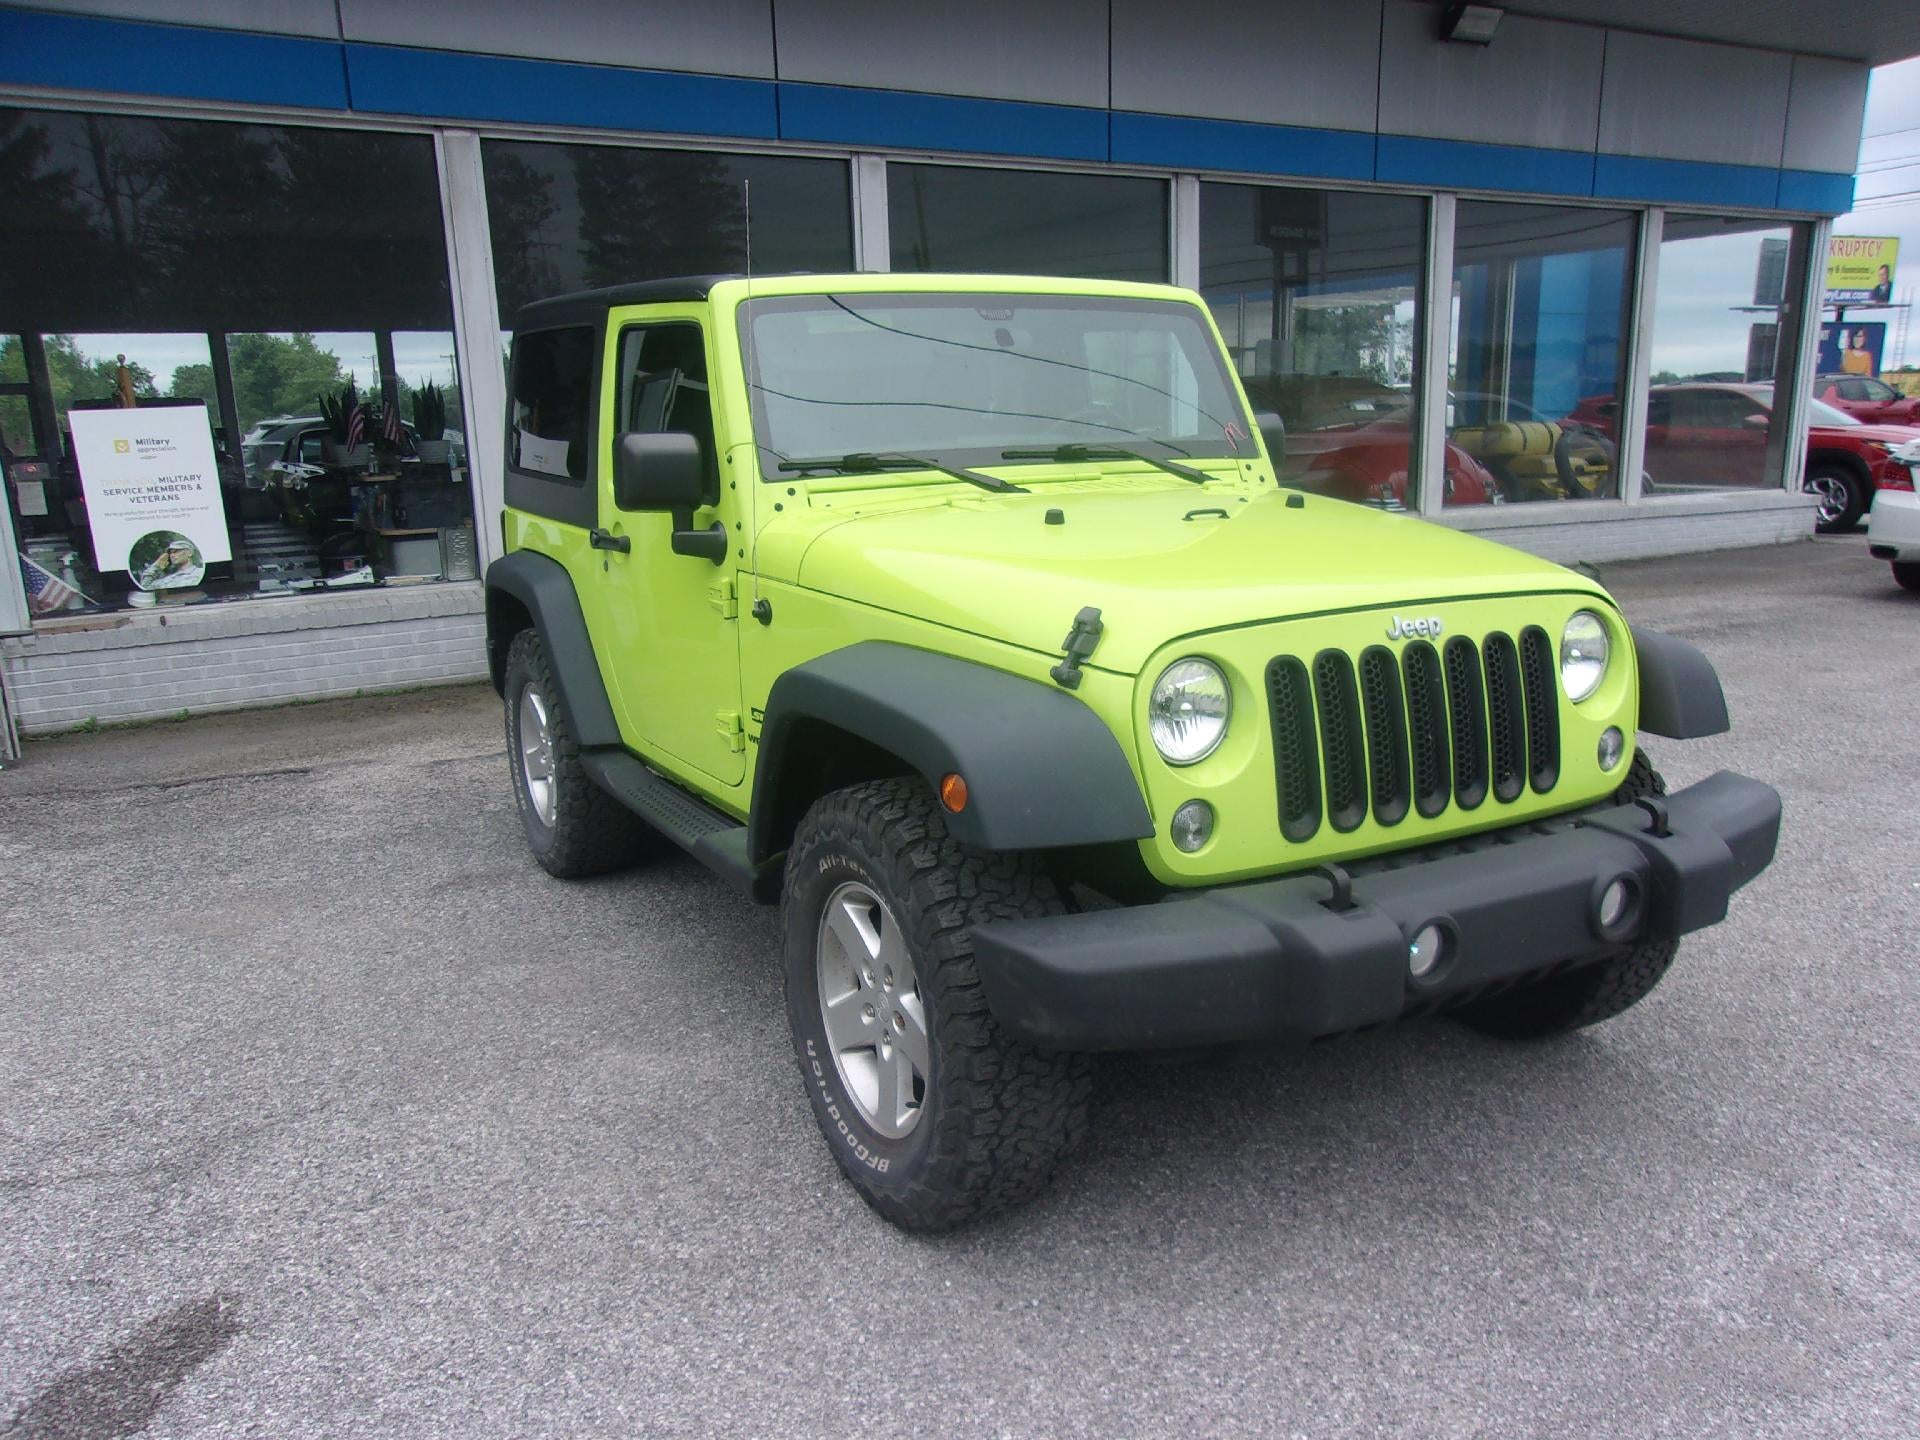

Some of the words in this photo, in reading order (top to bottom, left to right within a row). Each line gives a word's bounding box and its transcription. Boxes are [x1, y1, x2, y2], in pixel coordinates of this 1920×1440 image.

[136, 438, 170, 446] Military
[158, 474, 202, 484] MILITARY
[102, 487, 144, 497] SERVICE
[147, 483, 193, 494] MEMBERS
[196, 483, 203, 491] &
[129, 493, 180, 504] VETERANS
[1386, 615, 1442, 640] Jeep
